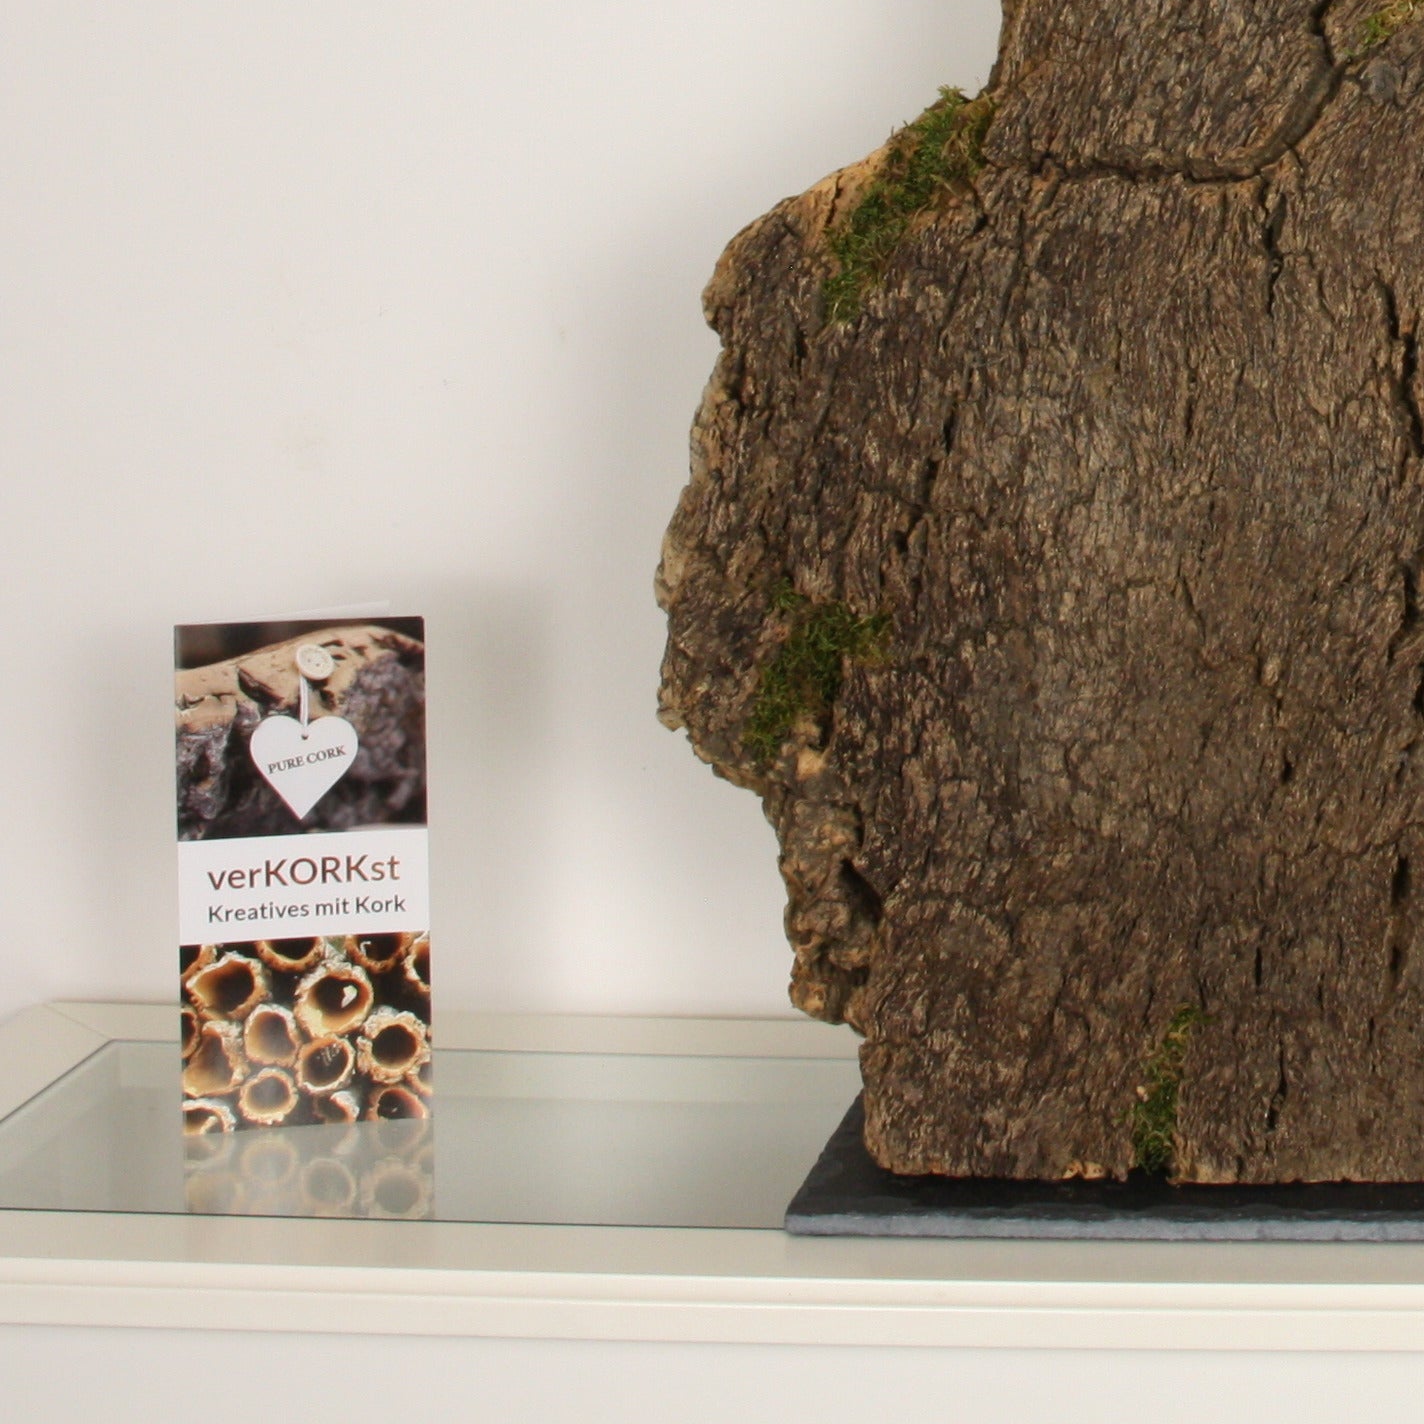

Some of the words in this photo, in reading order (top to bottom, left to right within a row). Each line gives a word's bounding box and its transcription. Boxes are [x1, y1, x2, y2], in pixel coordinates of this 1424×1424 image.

[267, 755, 305, 774] PURE
[306, 745, 346, 764] CORK
[207, 854, 400, 891] verKORKst
[208, 901, 310, 924] Kreatives
[315, 897, 350, 917] mit
[355, 894, 406, 914] Kork
